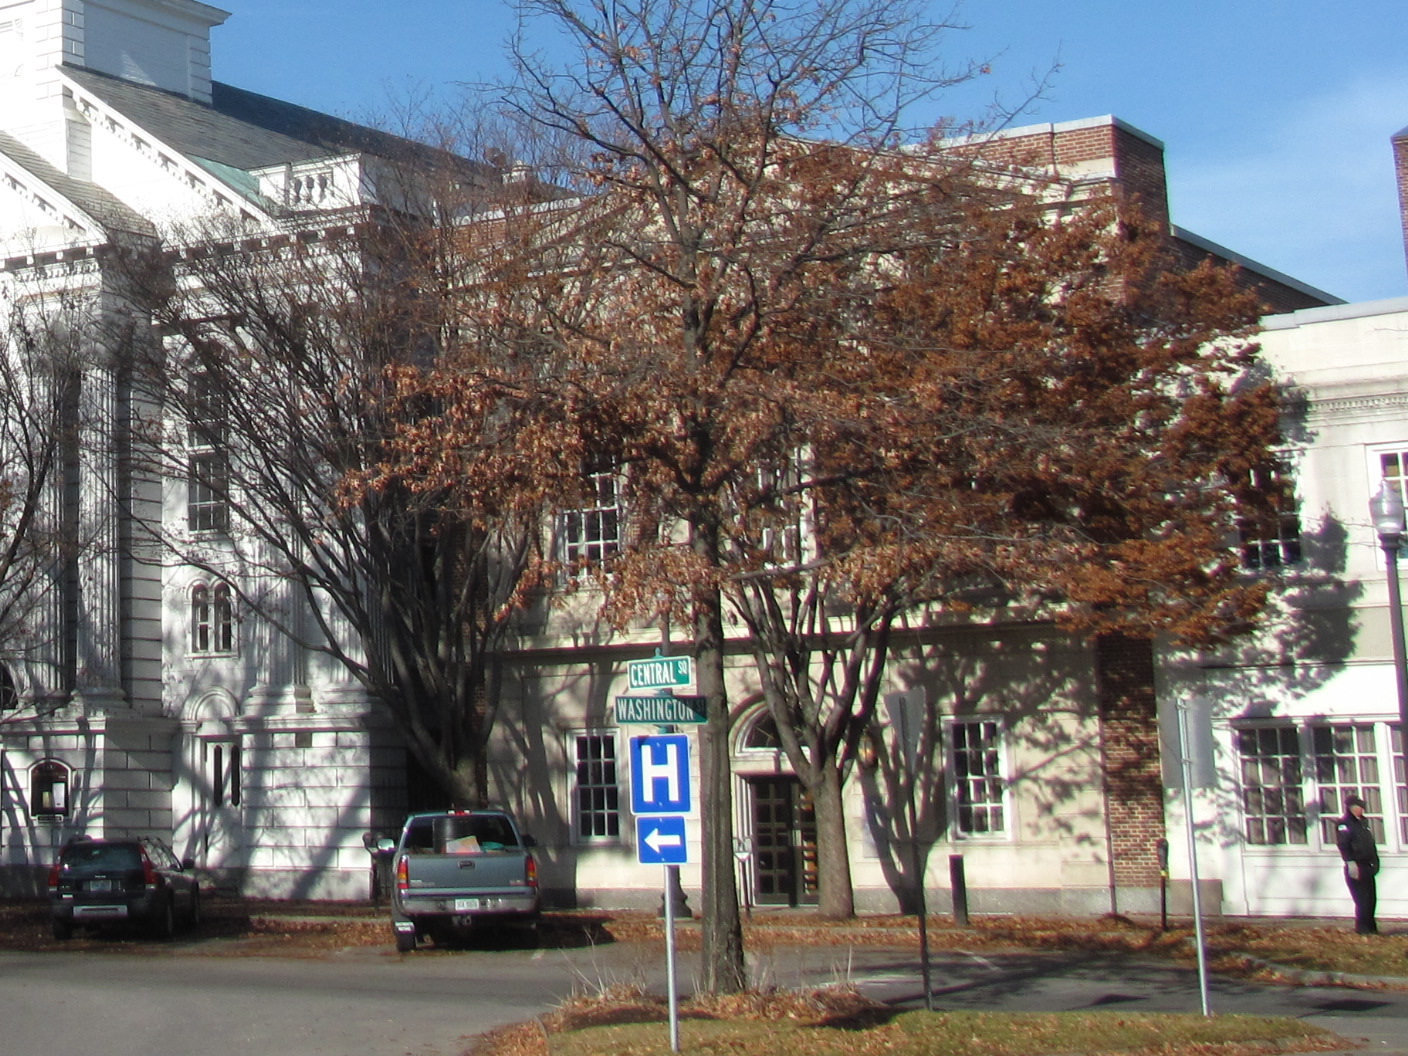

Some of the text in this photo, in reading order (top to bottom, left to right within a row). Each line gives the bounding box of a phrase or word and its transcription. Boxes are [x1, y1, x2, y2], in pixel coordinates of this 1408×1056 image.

[631, 660, 688, 686] CENTRAL SQ
[617, 698, 694, 721] WASHINGTON
[641, 744, 680, 803] H
